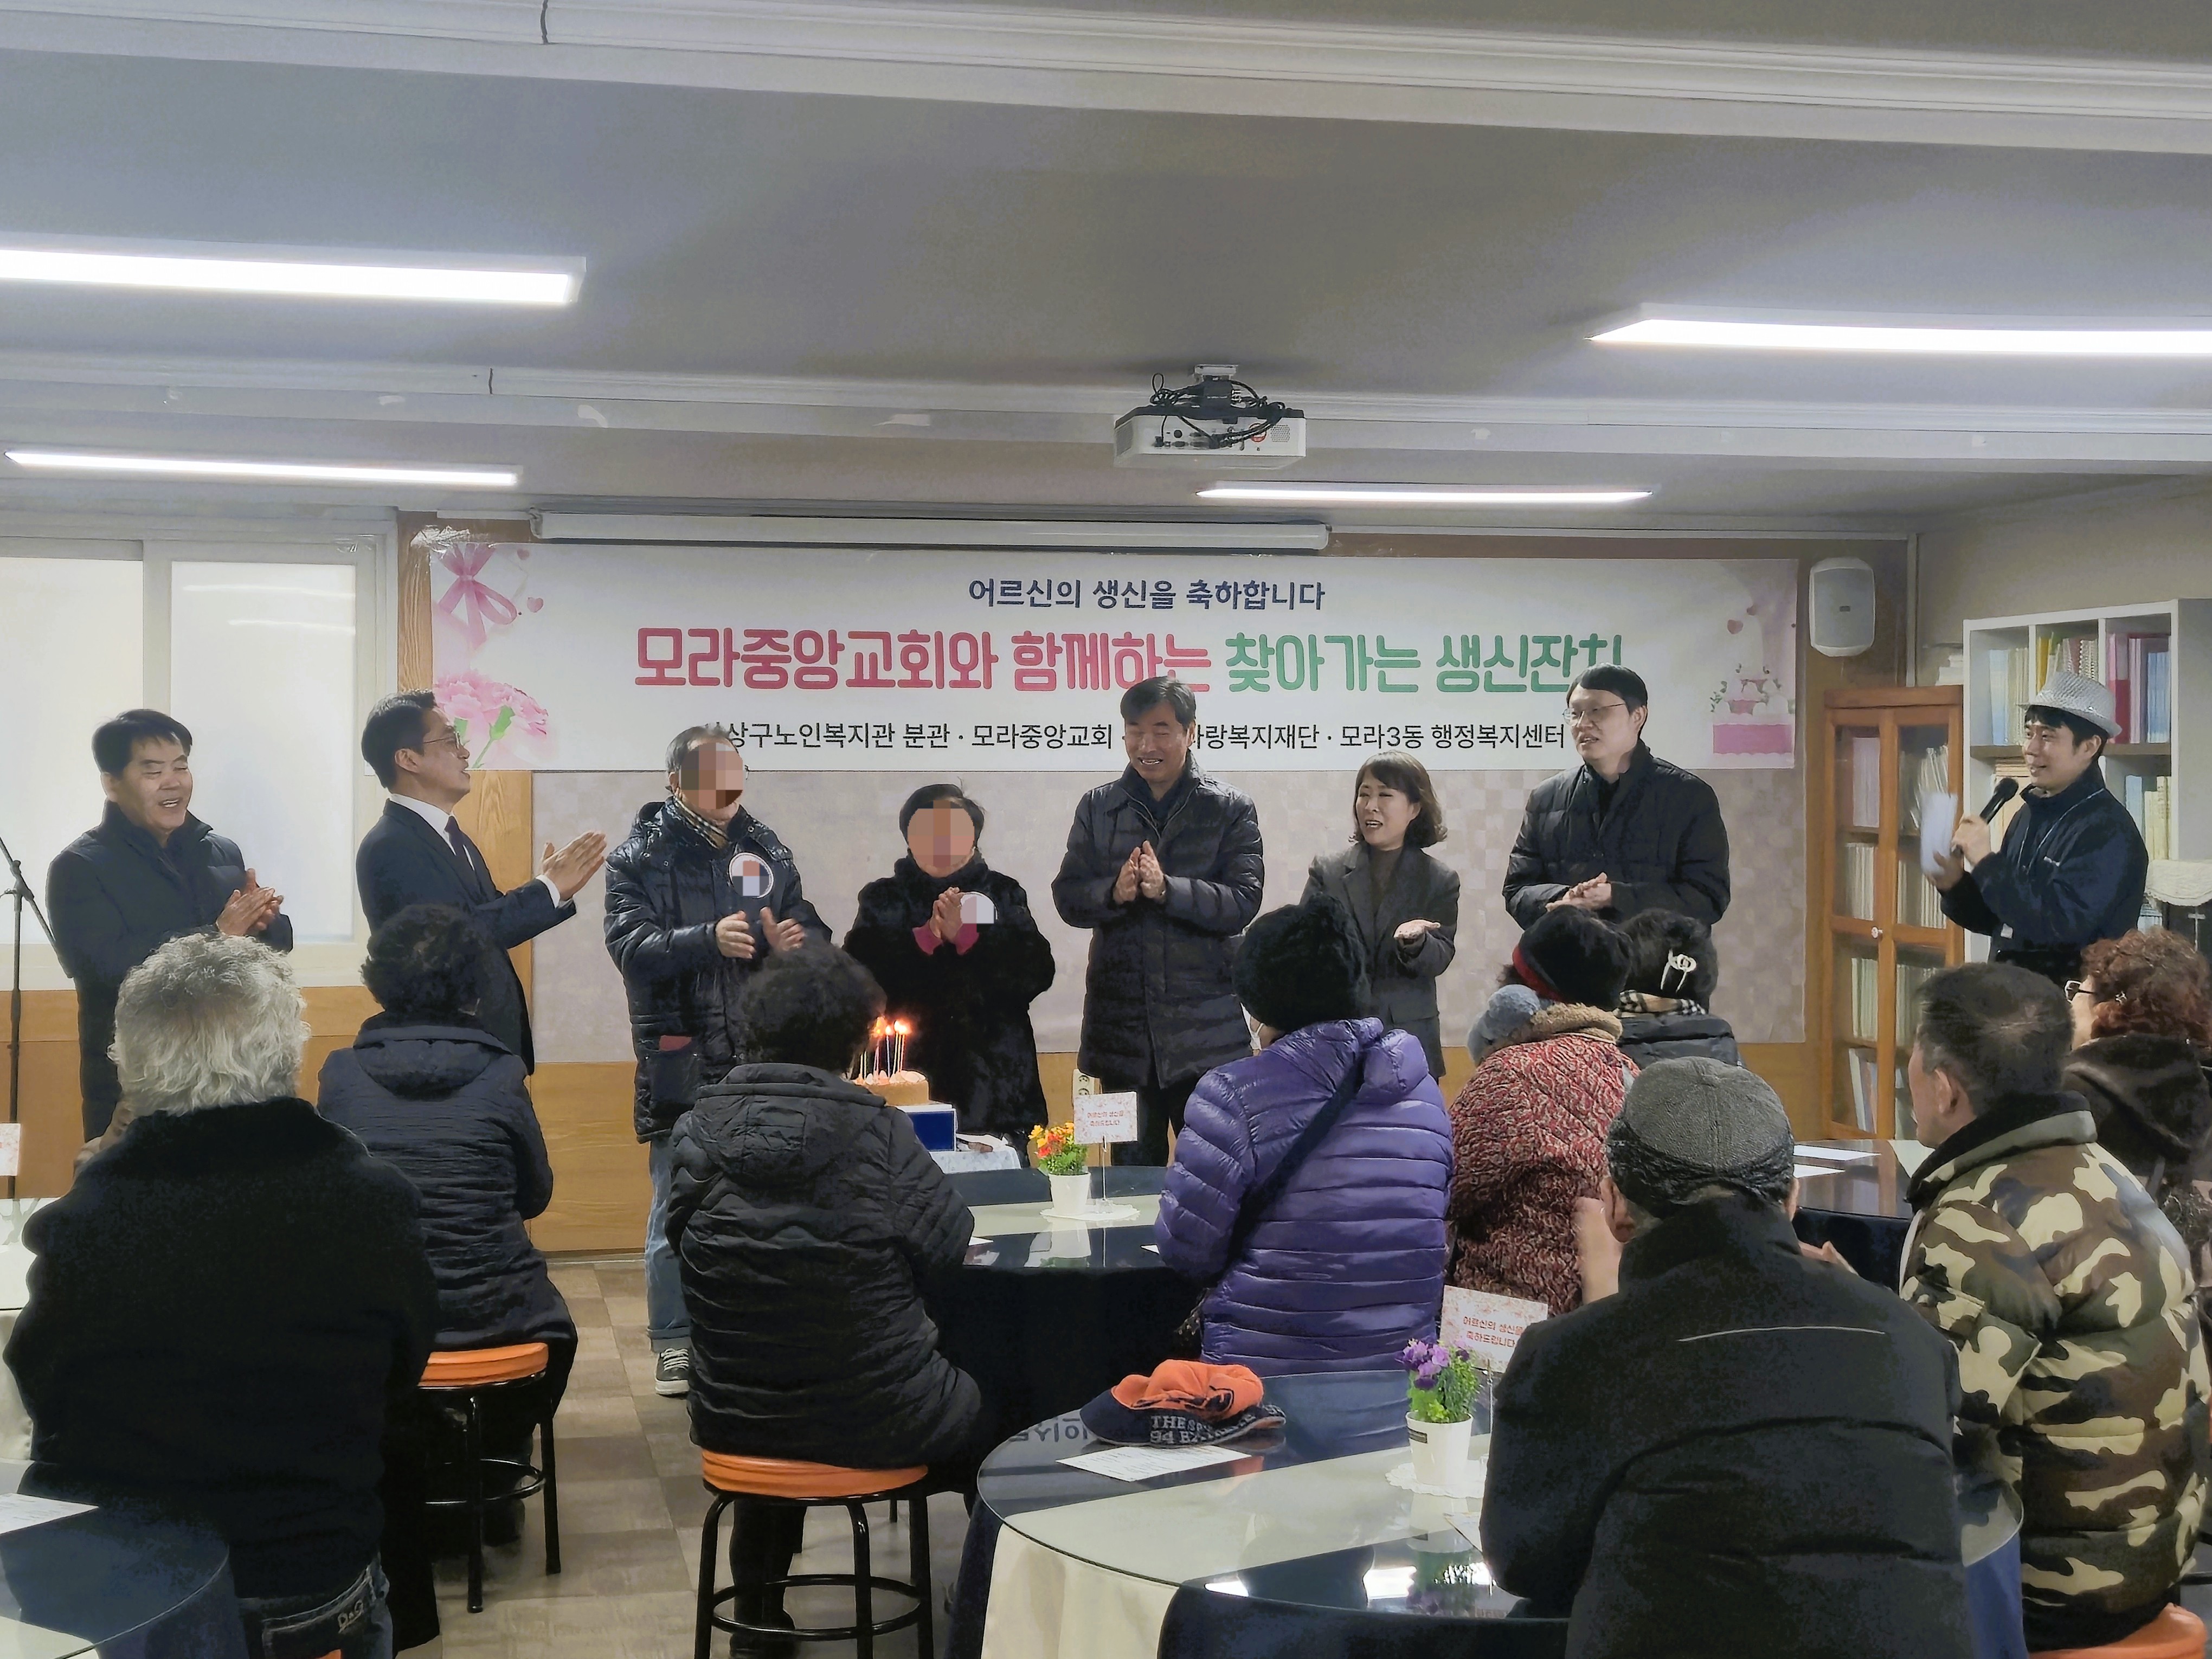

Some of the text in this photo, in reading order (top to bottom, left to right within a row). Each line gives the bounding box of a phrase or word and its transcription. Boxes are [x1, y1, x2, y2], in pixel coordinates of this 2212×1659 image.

[968, 578, 1326, 611] 어르신의 생신을 축하합니다
[635, 628, 998, 691] 모라중앙교회와
[1225, 632, 1420, 693] 찾아가는
[706, 721, 1565, 750] 상구노인복지관 분관 모라중앙교회 랑복지재단 모라3동 행정복지센터
[1463, 1316, 1496, 1330] 어르신의
[1150, 1415, 1186, 1429] THE
